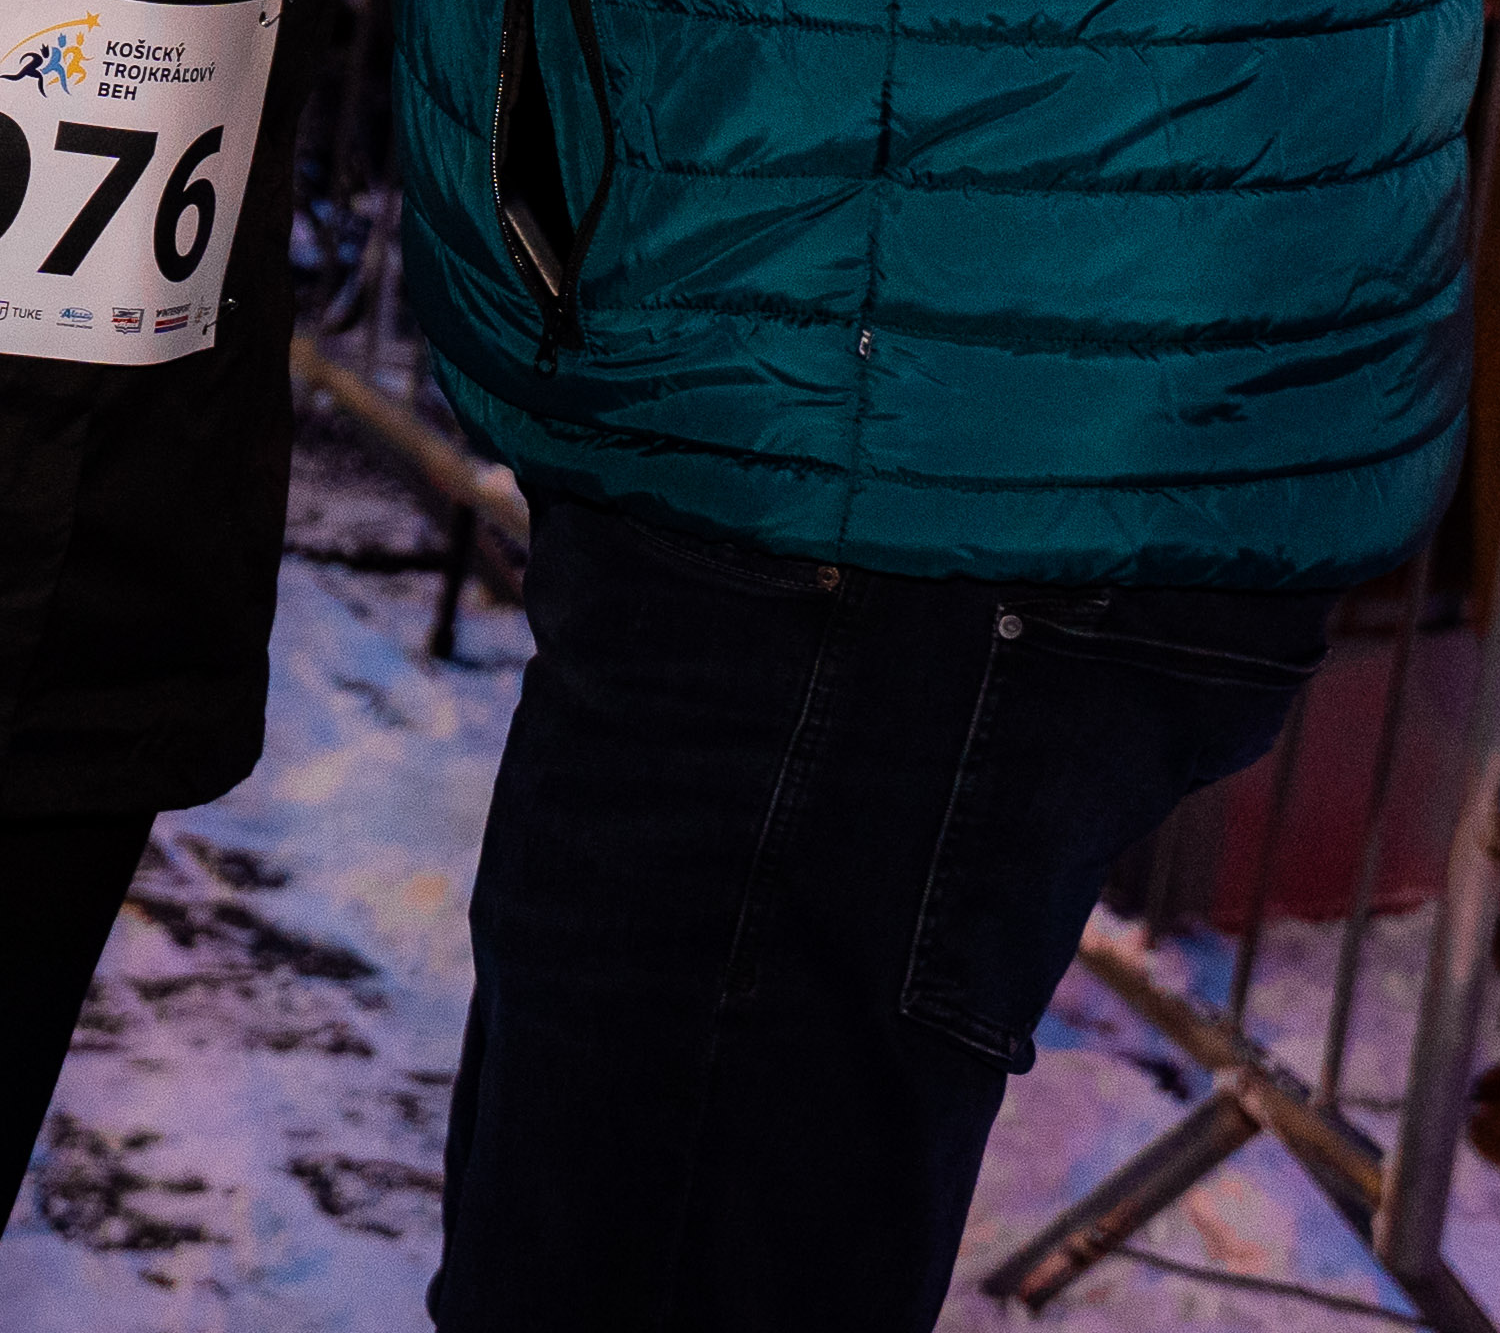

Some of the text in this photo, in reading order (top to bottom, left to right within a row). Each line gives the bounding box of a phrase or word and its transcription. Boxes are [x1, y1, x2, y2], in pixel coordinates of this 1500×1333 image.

[105, 39, 186, 63] KOŠICKÝ
[102, 61, 216, 84] TROJKRÁĽOVÝ
[97, 82, 138, 101] BEH
[12, 307, 43, 321] TUKE
